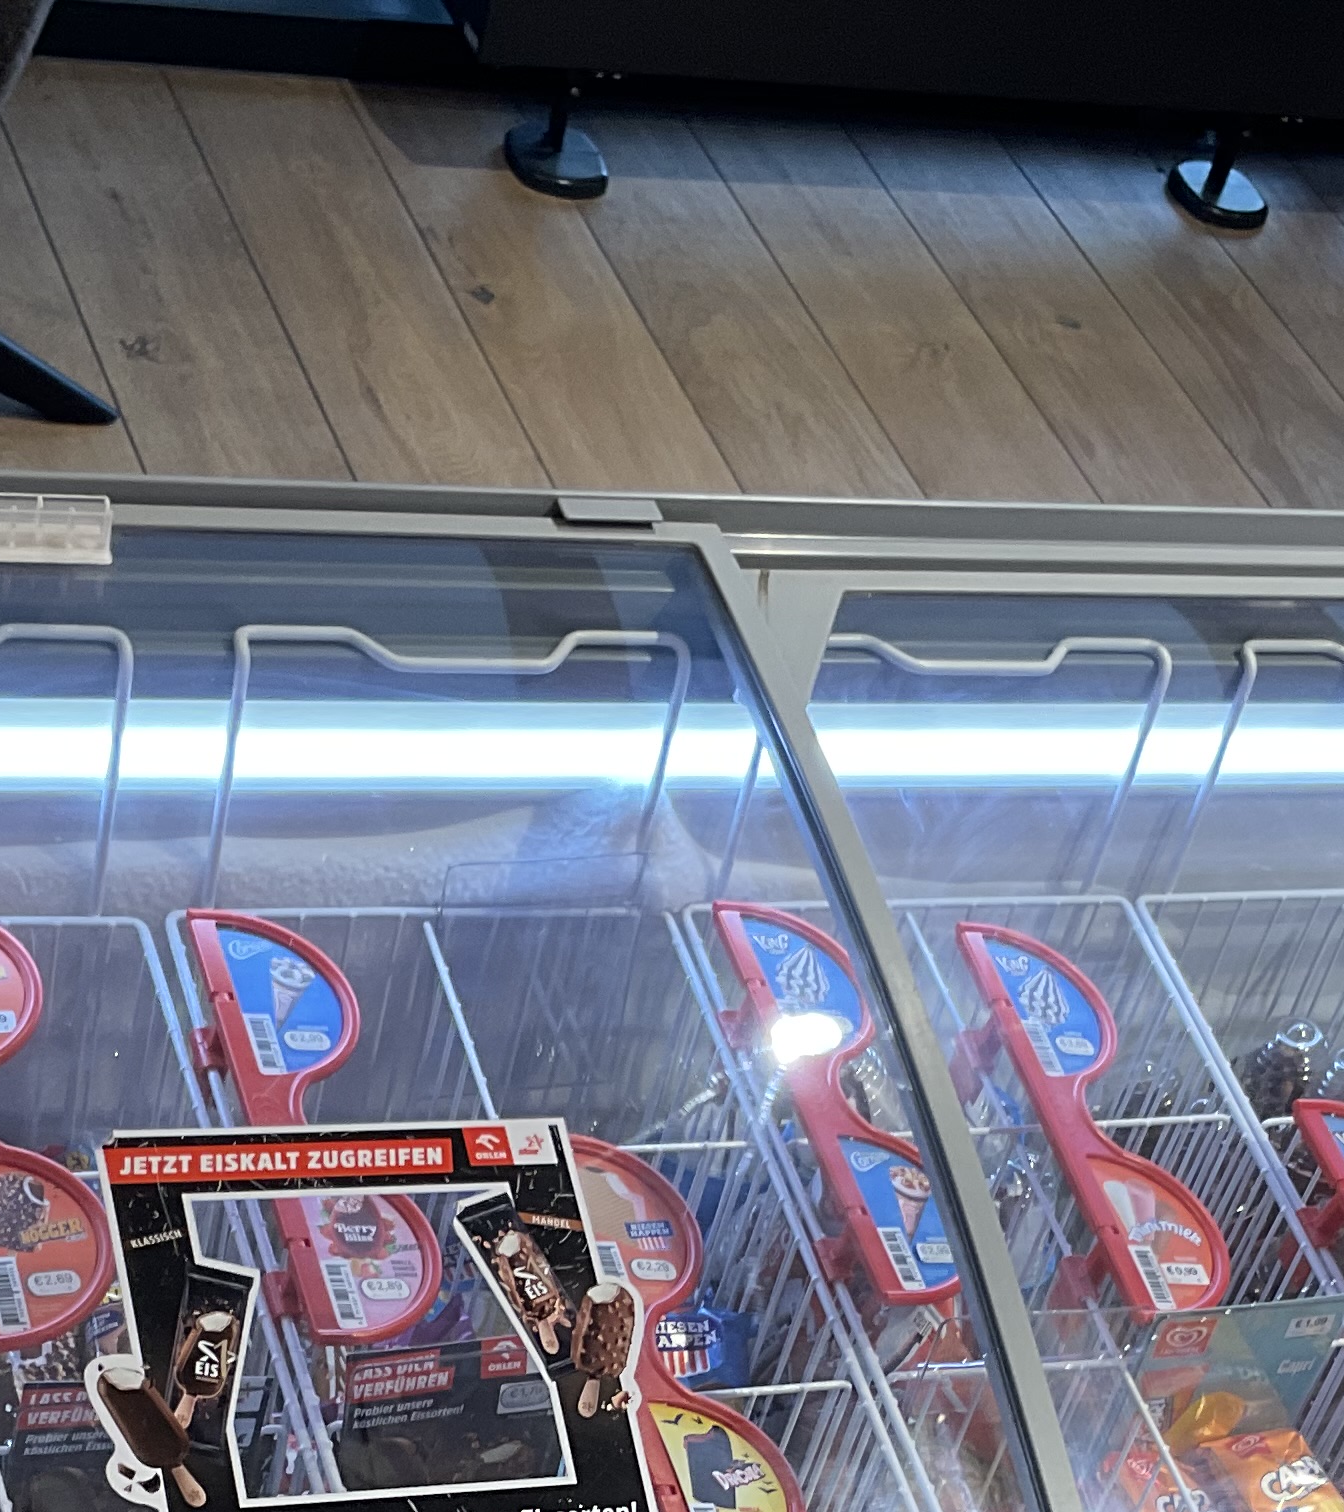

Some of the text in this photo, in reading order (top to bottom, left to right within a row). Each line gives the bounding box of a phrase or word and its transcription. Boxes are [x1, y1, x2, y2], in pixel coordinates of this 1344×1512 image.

[119, 1146, 443, 1176] JETZT EISKALT ZUGREIFEN
[475, 1151, 507, 1160] ORLEN
[20, 1218, 84, 1244] NOGGER
[334, 1223, 376, 1237] Berry
[532, 1215, 571, 1229] MANDEL
[130, 1229, 182, 1249] KLASSISCH
[631, 1228, 670, 1237] HAPPEN
[525, 1281, 548, 1300] EIS
[195, 1360, 219, 1377] EIS
[487, 1361, 521, 1372] ORLEN
[353, 1371, 449, 1399] VERFÜHREN
[353, 1404, 465, 1429] köstlichen Eissorten!
[354, 1399, 434, 1419] Probier unsere
[25, 1432, 69, 1444] Probier
